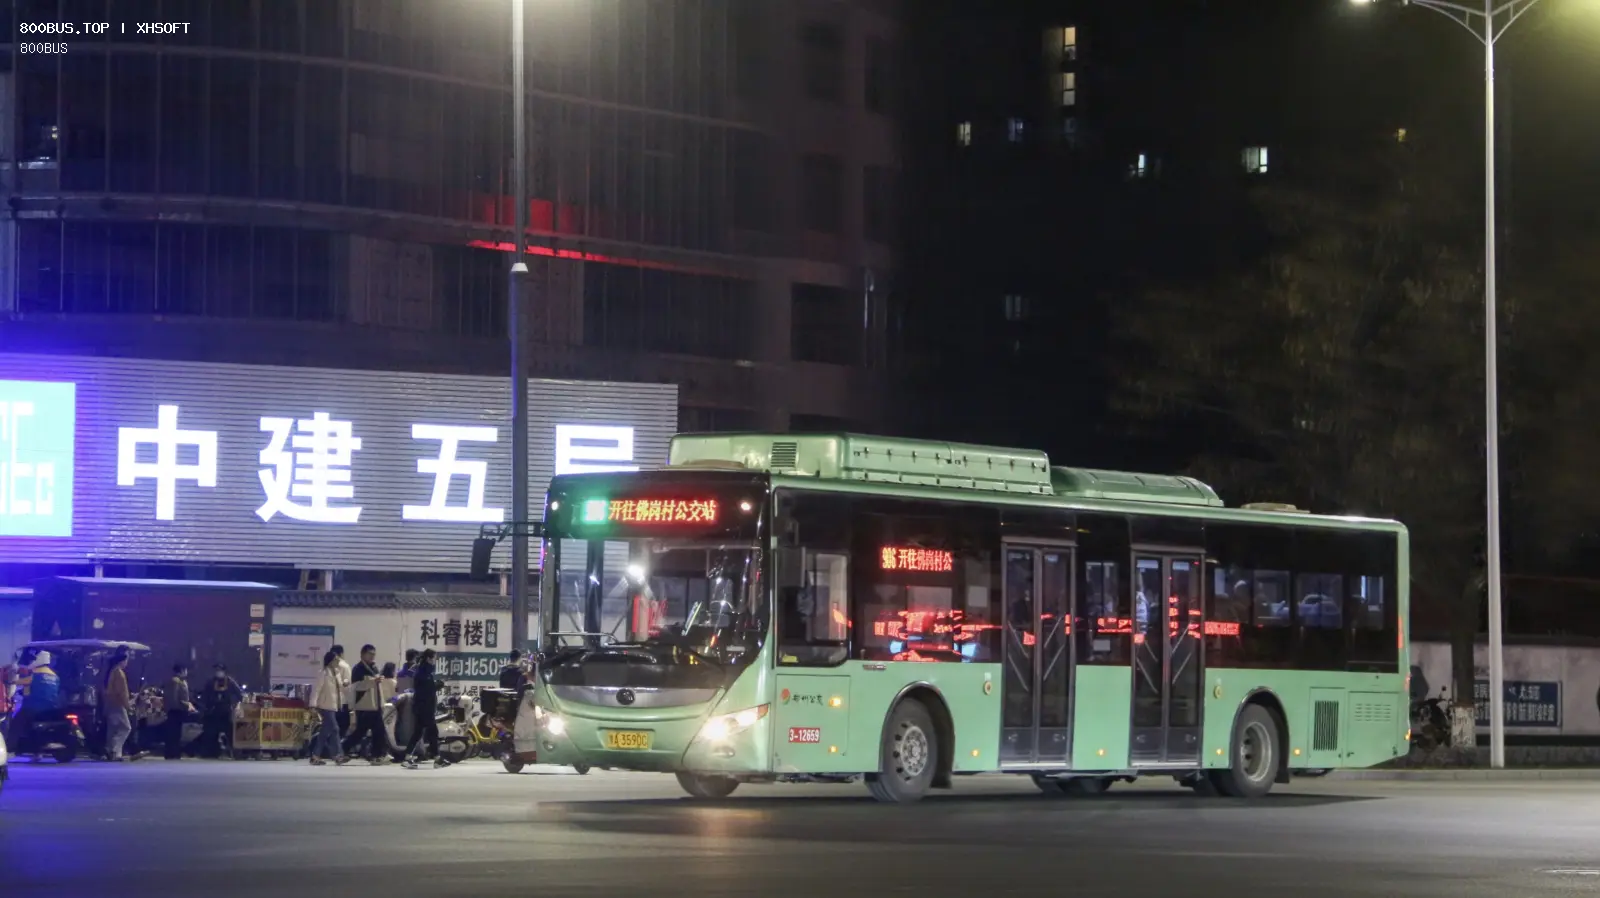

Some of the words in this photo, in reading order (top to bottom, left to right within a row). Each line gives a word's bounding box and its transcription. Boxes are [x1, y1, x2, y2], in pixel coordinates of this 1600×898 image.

[420, 618, 483, 646] 科睿楼
[789, 728, 820, 742] 3-12659
